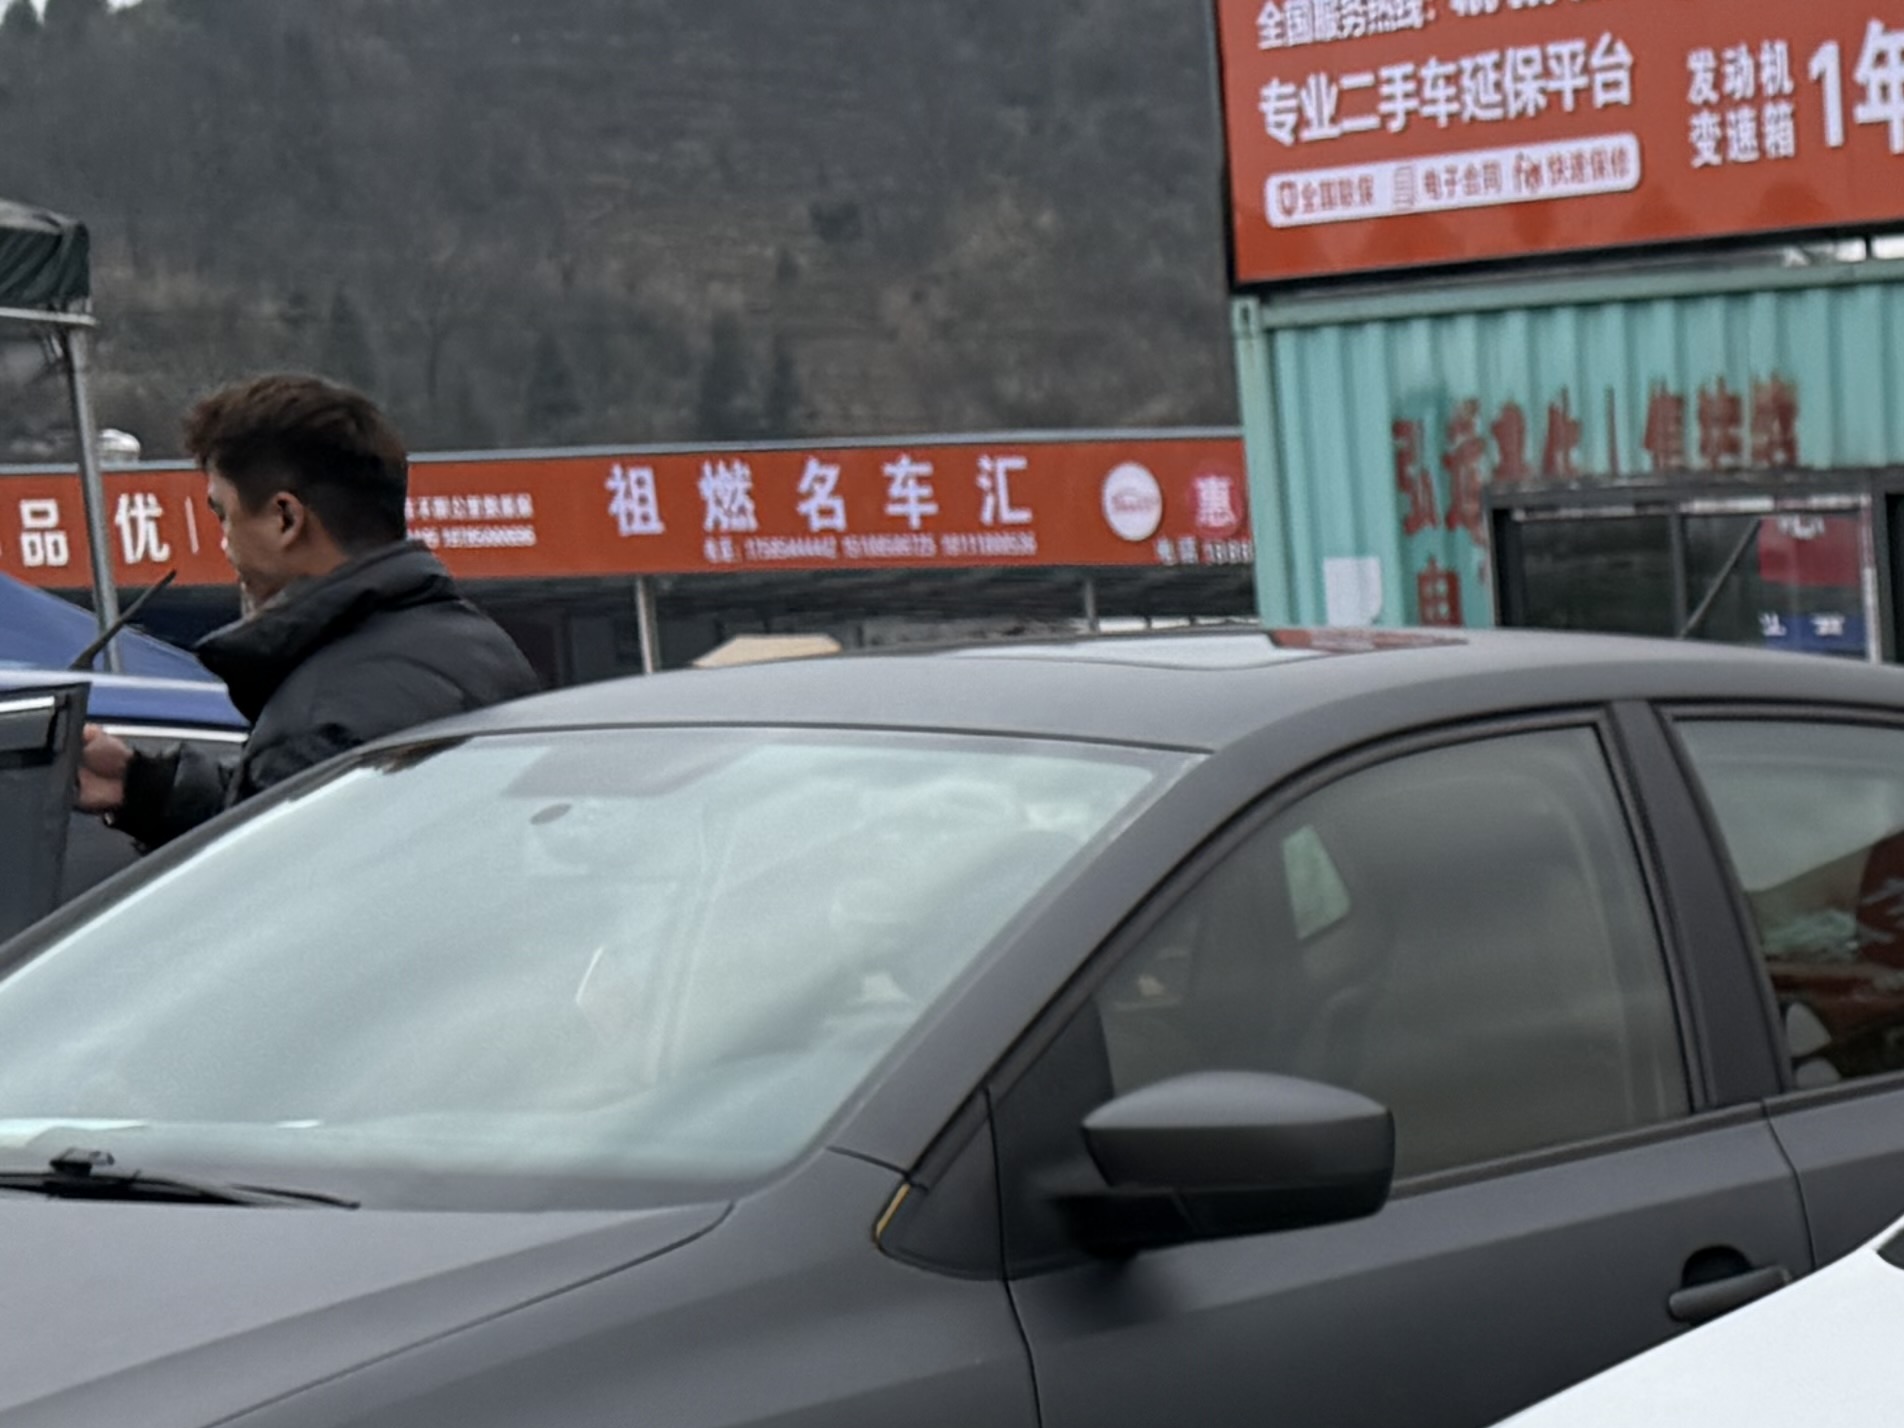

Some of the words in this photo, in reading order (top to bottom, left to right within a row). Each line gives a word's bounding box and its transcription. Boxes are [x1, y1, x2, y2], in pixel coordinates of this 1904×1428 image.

[1259, 32, 1635, 147] 专业二手车延保平台
[1686, 40, 1794, 105] 发动机
[1688, 103, 1797, 169] 变速箱
